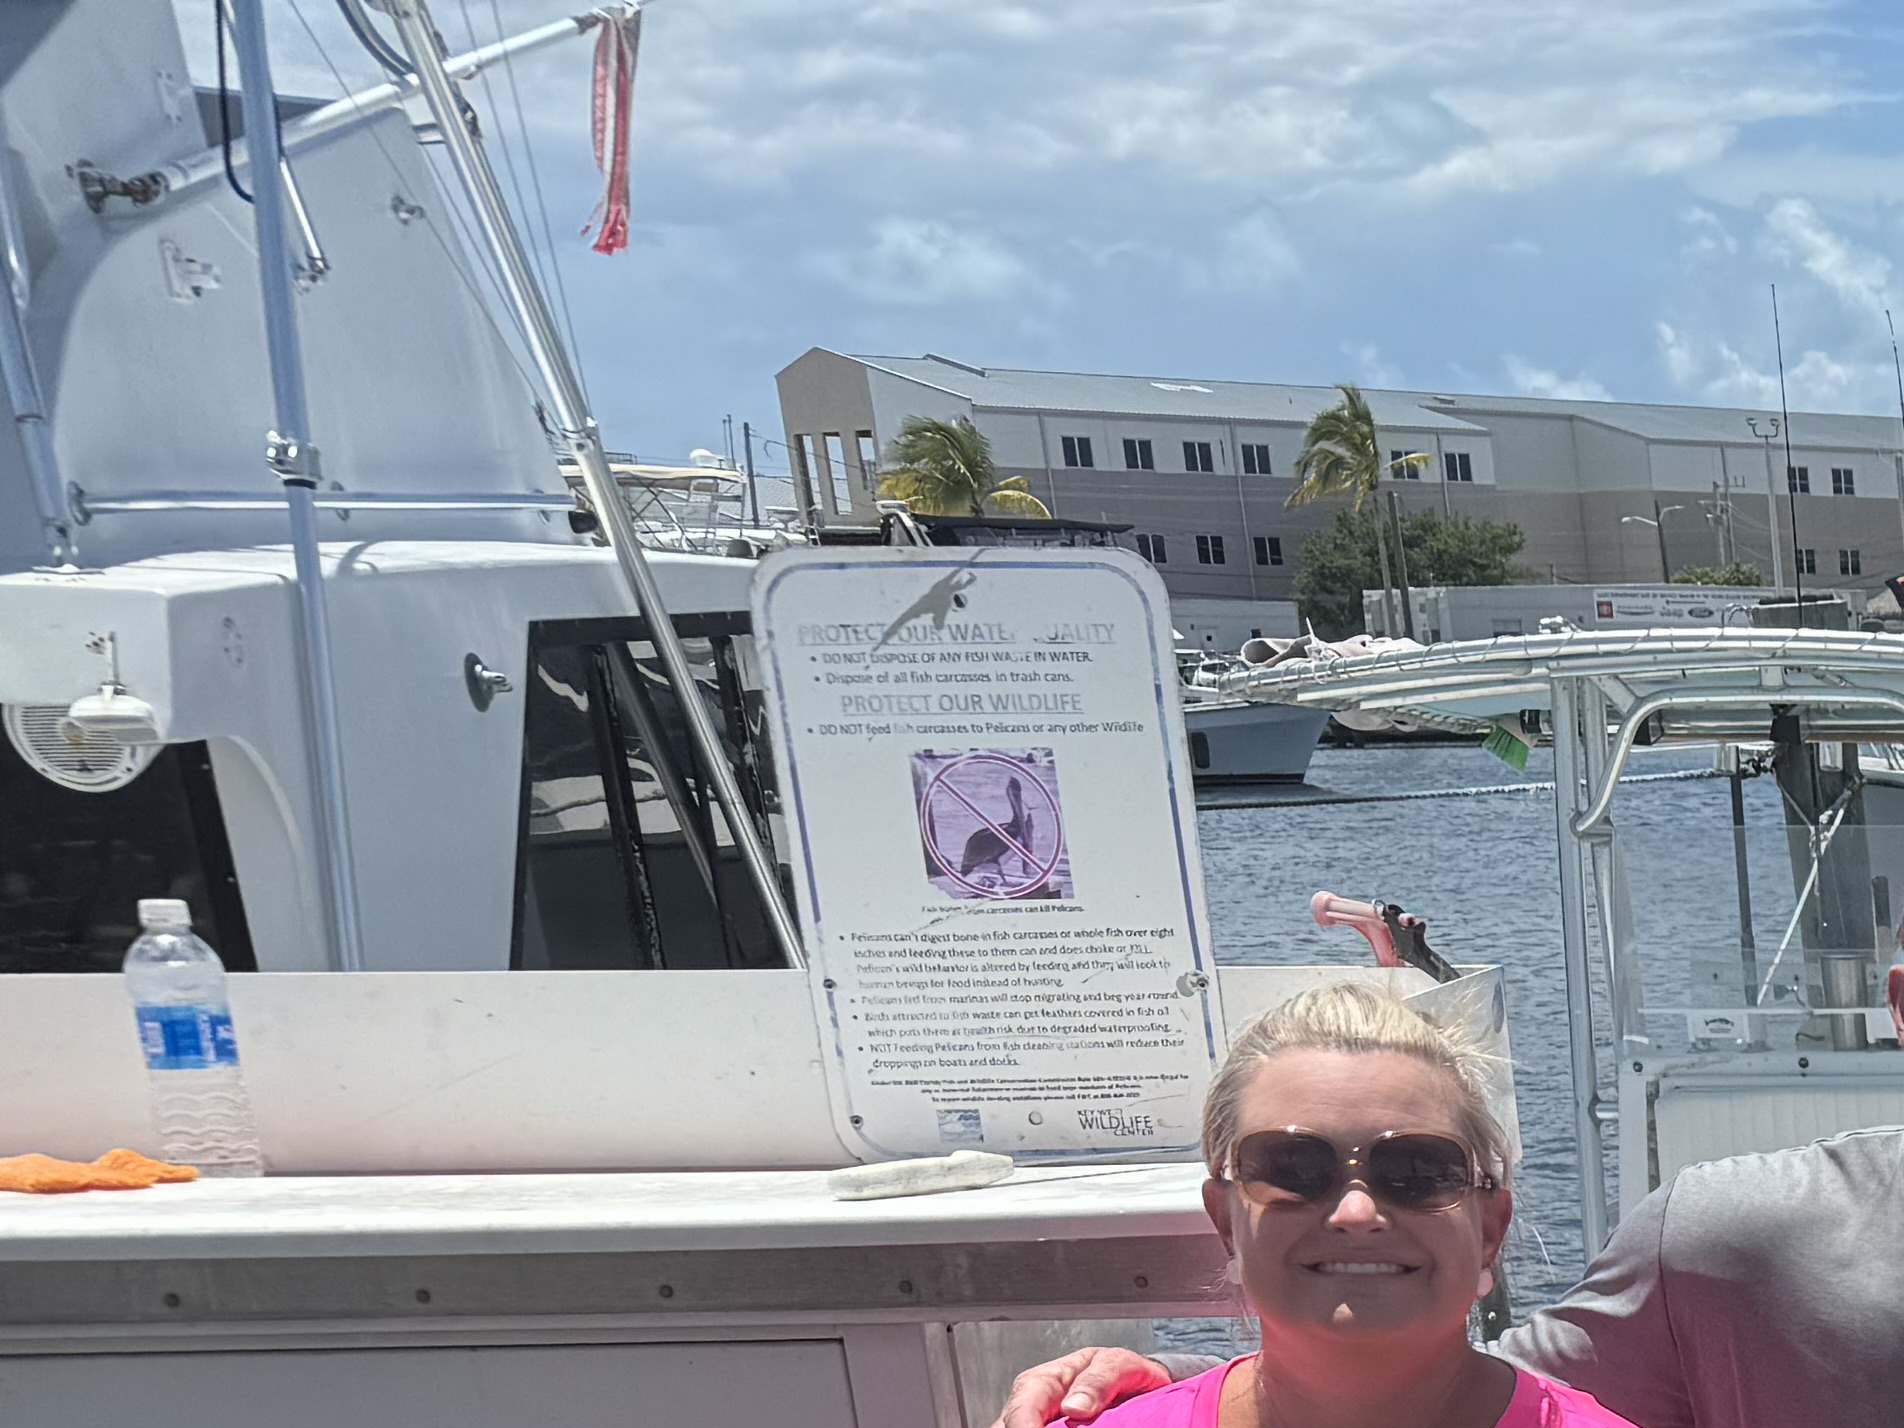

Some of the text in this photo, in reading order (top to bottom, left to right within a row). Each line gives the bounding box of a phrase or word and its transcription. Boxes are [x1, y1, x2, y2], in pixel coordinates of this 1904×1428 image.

[798, 622, 1115, 644] PROTECT OUR WATE UALITY
[822, 652, 841, 664] DO
[843, 652, 867, 664] NOT
[870, 651, 919, 664] DISPOSE
[921, 652, 935, 664] OF
[939, 651, 962, 664] ANY
[965, 651, 989, 663] FISH
[992, 651, 1031, 663] WAE
[1034, 651, 1046, 663] IN
[826, 671, 873, 685] Dispose
[876, 671, 889, 684] of
[894, 670, 908, 683] all
[910, 670, 932, 683] fish
[935, 672, 991, 683] carcasses
[995, 670, 1007, 682] in
[1009, 670, 1042, 682] trash
[840, 693, 1083, 713] PROTECT OUR WILDLIFE
[819, 723, 837, 735] DO
[840, 723, 863, 735] NOT
[866, 723, 891, 736] feed
[916, 724, 969, 735] carcasses
[971, 723, 983, 734] to
[985, 722, 1030, 734] Pelicans
[1032, 724, 1044, 734] or
[1047, 723, 1067, 735] any
[1069, 722, 1099, 733] other
[1078, 1114, 1153, 1130] WILDLIFE
